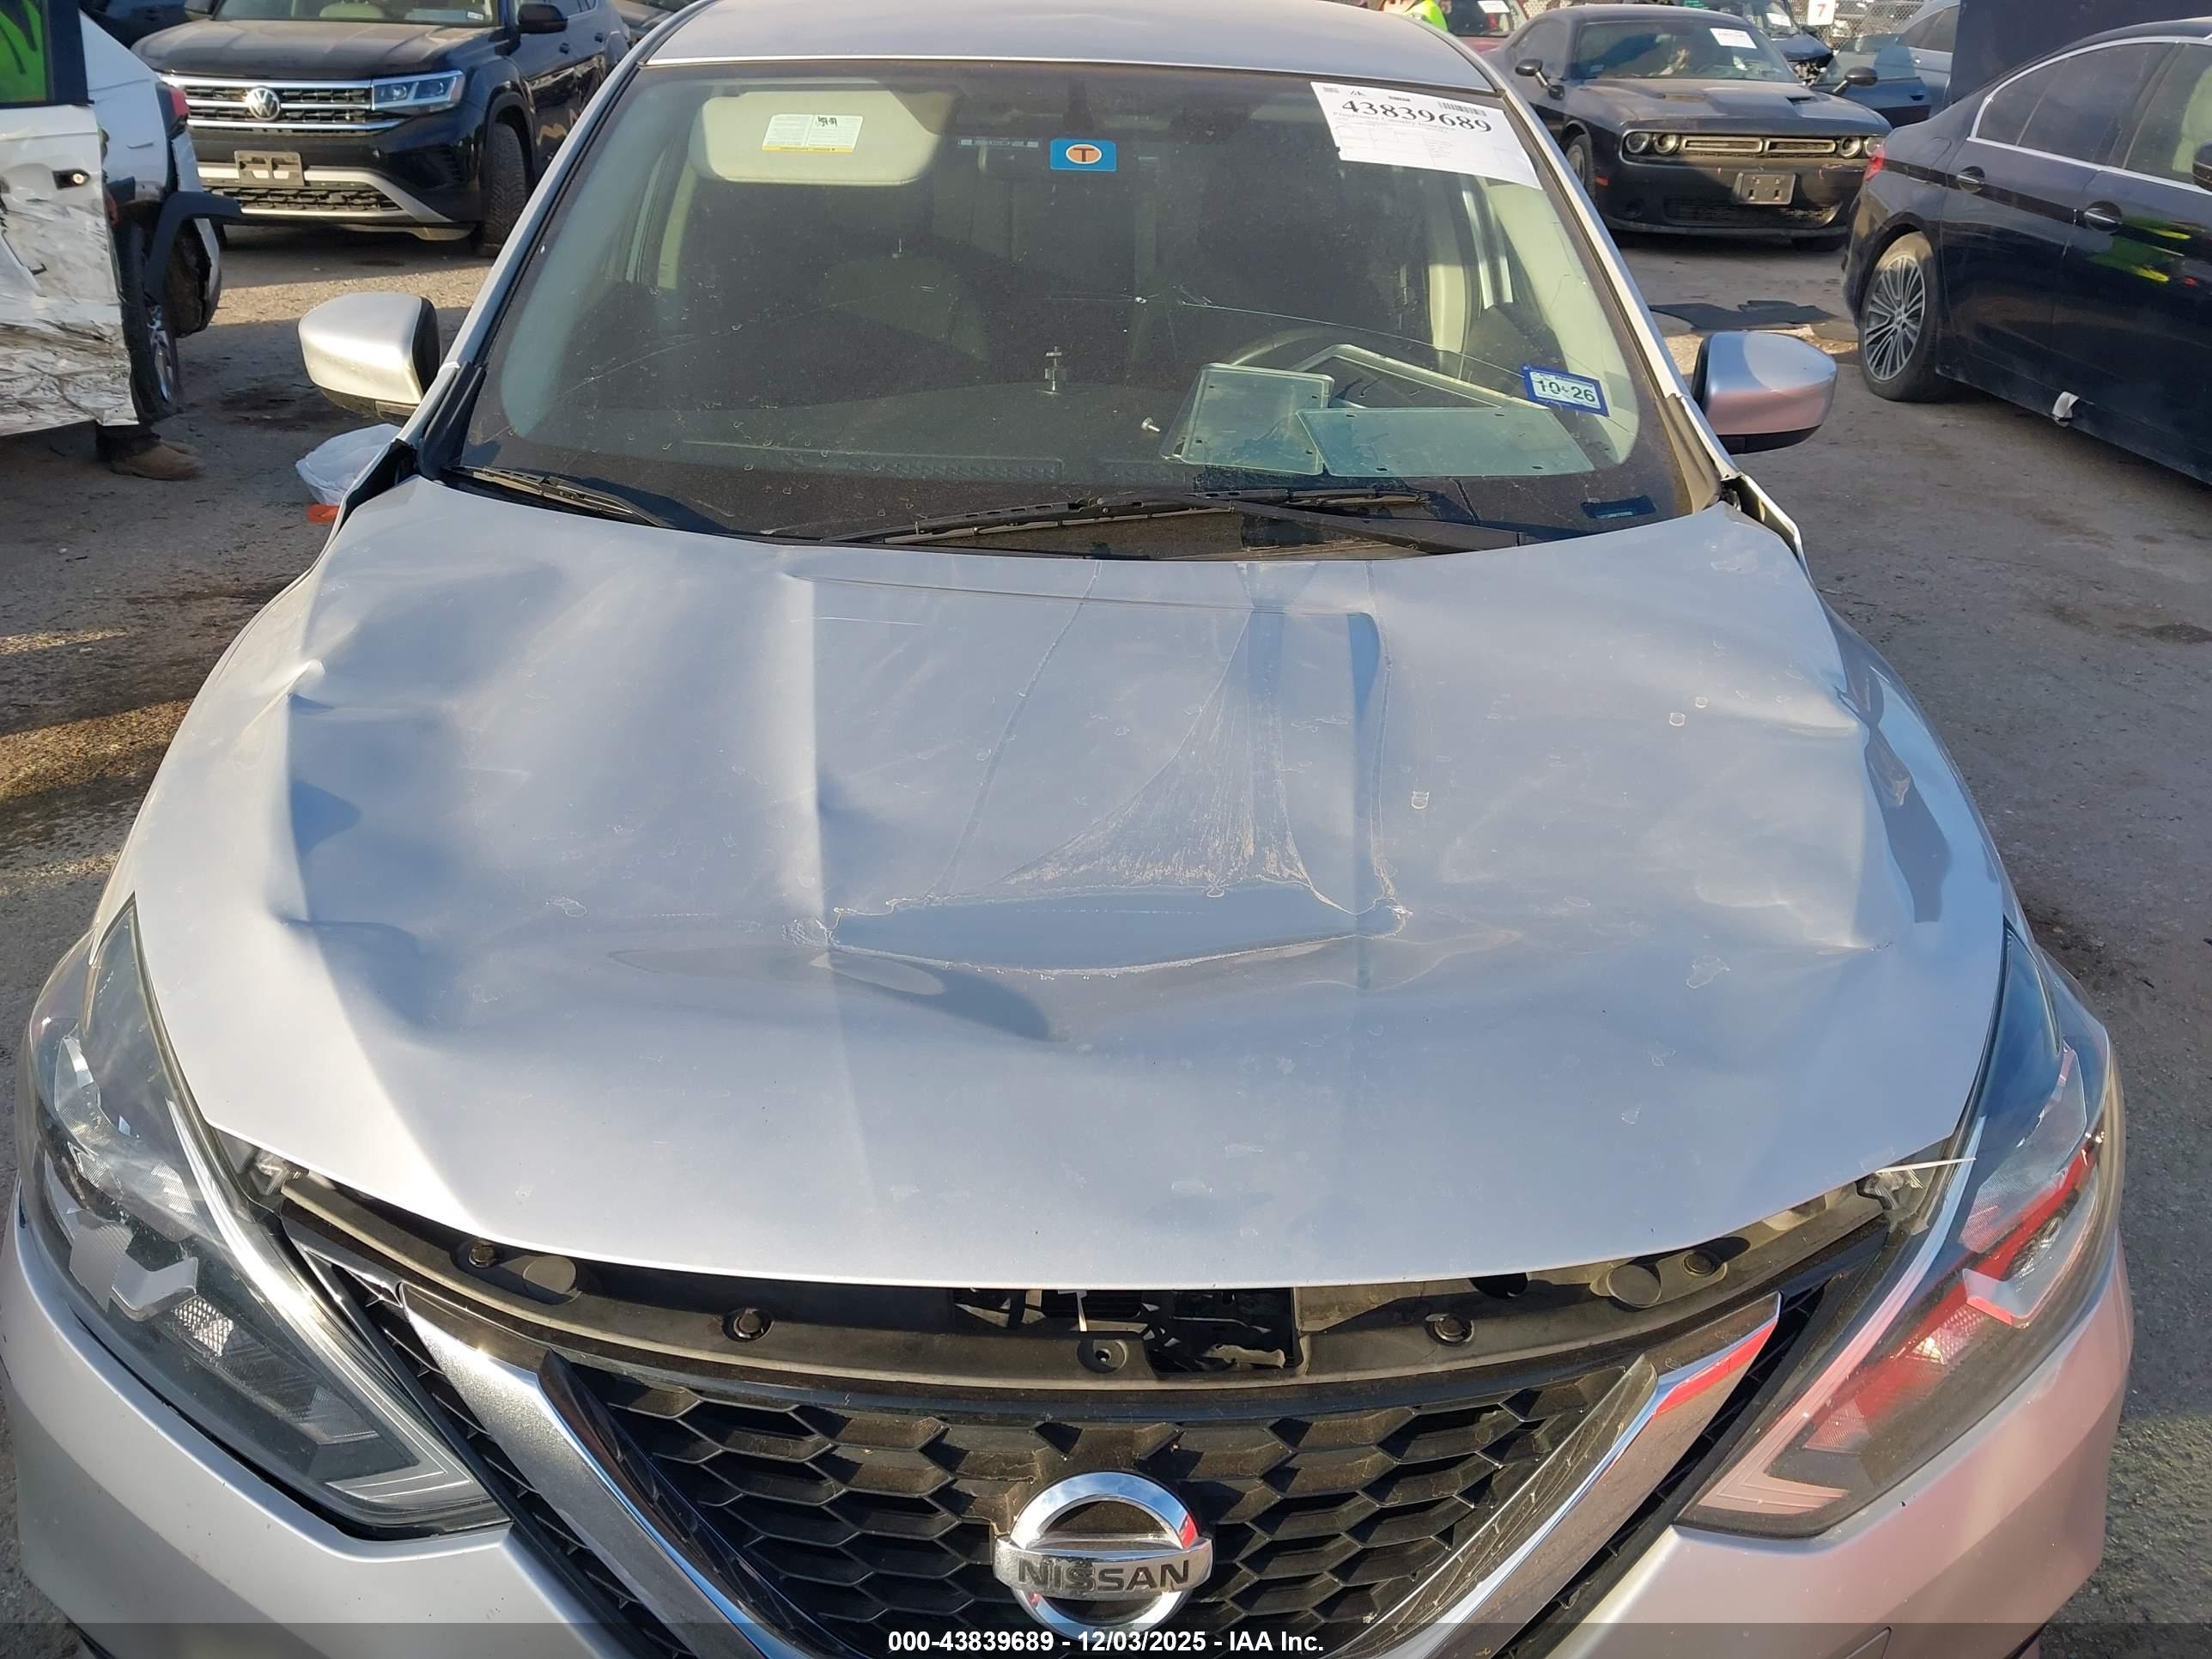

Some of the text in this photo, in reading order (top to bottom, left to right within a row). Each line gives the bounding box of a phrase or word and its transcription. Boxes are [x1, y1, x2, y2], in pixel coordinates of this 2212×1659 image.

[1817, 4, 1826, 17] 7
[1341, 100, 1492, 132] 43839689
[1073, 148, 1095, 162] T
[1571, 386, 1595, 402] 26
[1018, 1559, 1190, 1594] NISSAN
